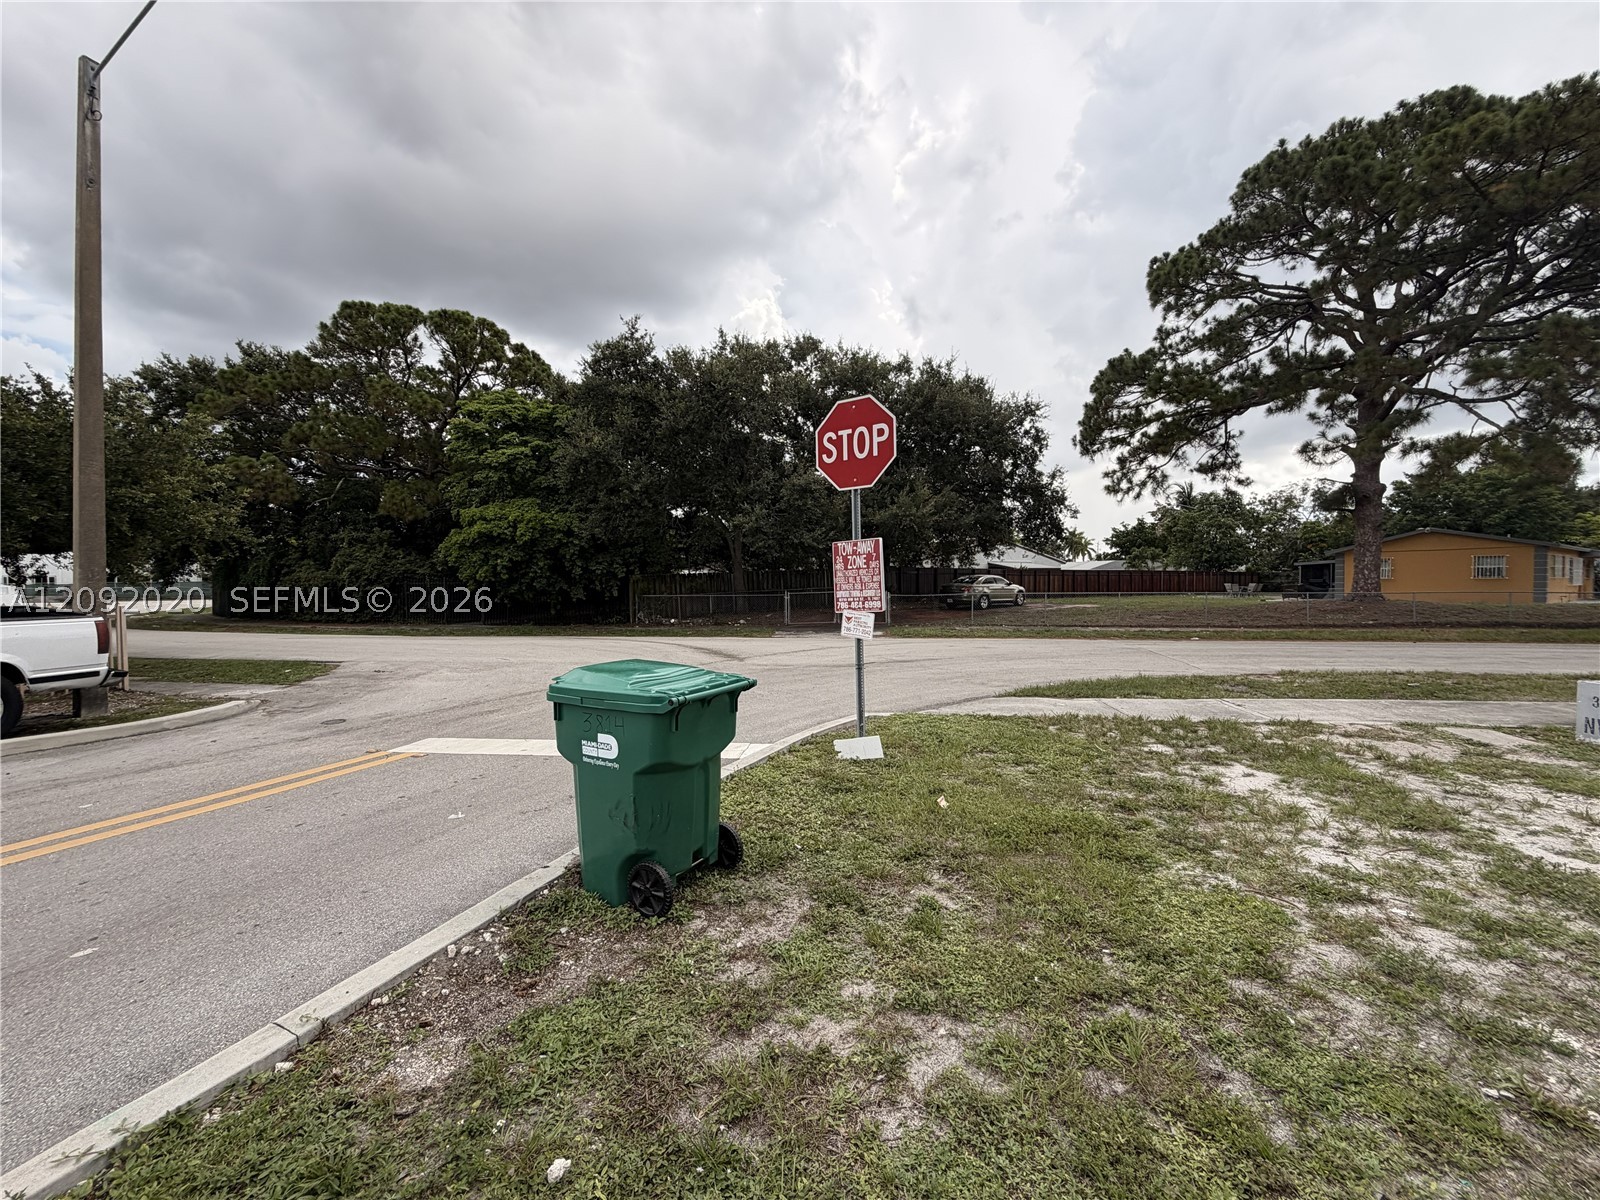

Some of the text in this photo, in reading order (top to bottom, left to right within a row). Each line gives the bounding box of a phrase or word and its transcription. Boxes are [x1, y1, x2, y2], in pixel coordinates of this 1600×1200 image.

[822, 423, 889, 464] STOP
[837, 540, 875, 556] TOW-AWAY
[836, 556, 843, 564] 24
[847, 554, 867, 569] ZONE
[869, 560, 880, 568] DAYS
[872, 553, 876, 561] 7
[582, 711, 626, 737] 3814
[1584, 716, 1600, 735] N
